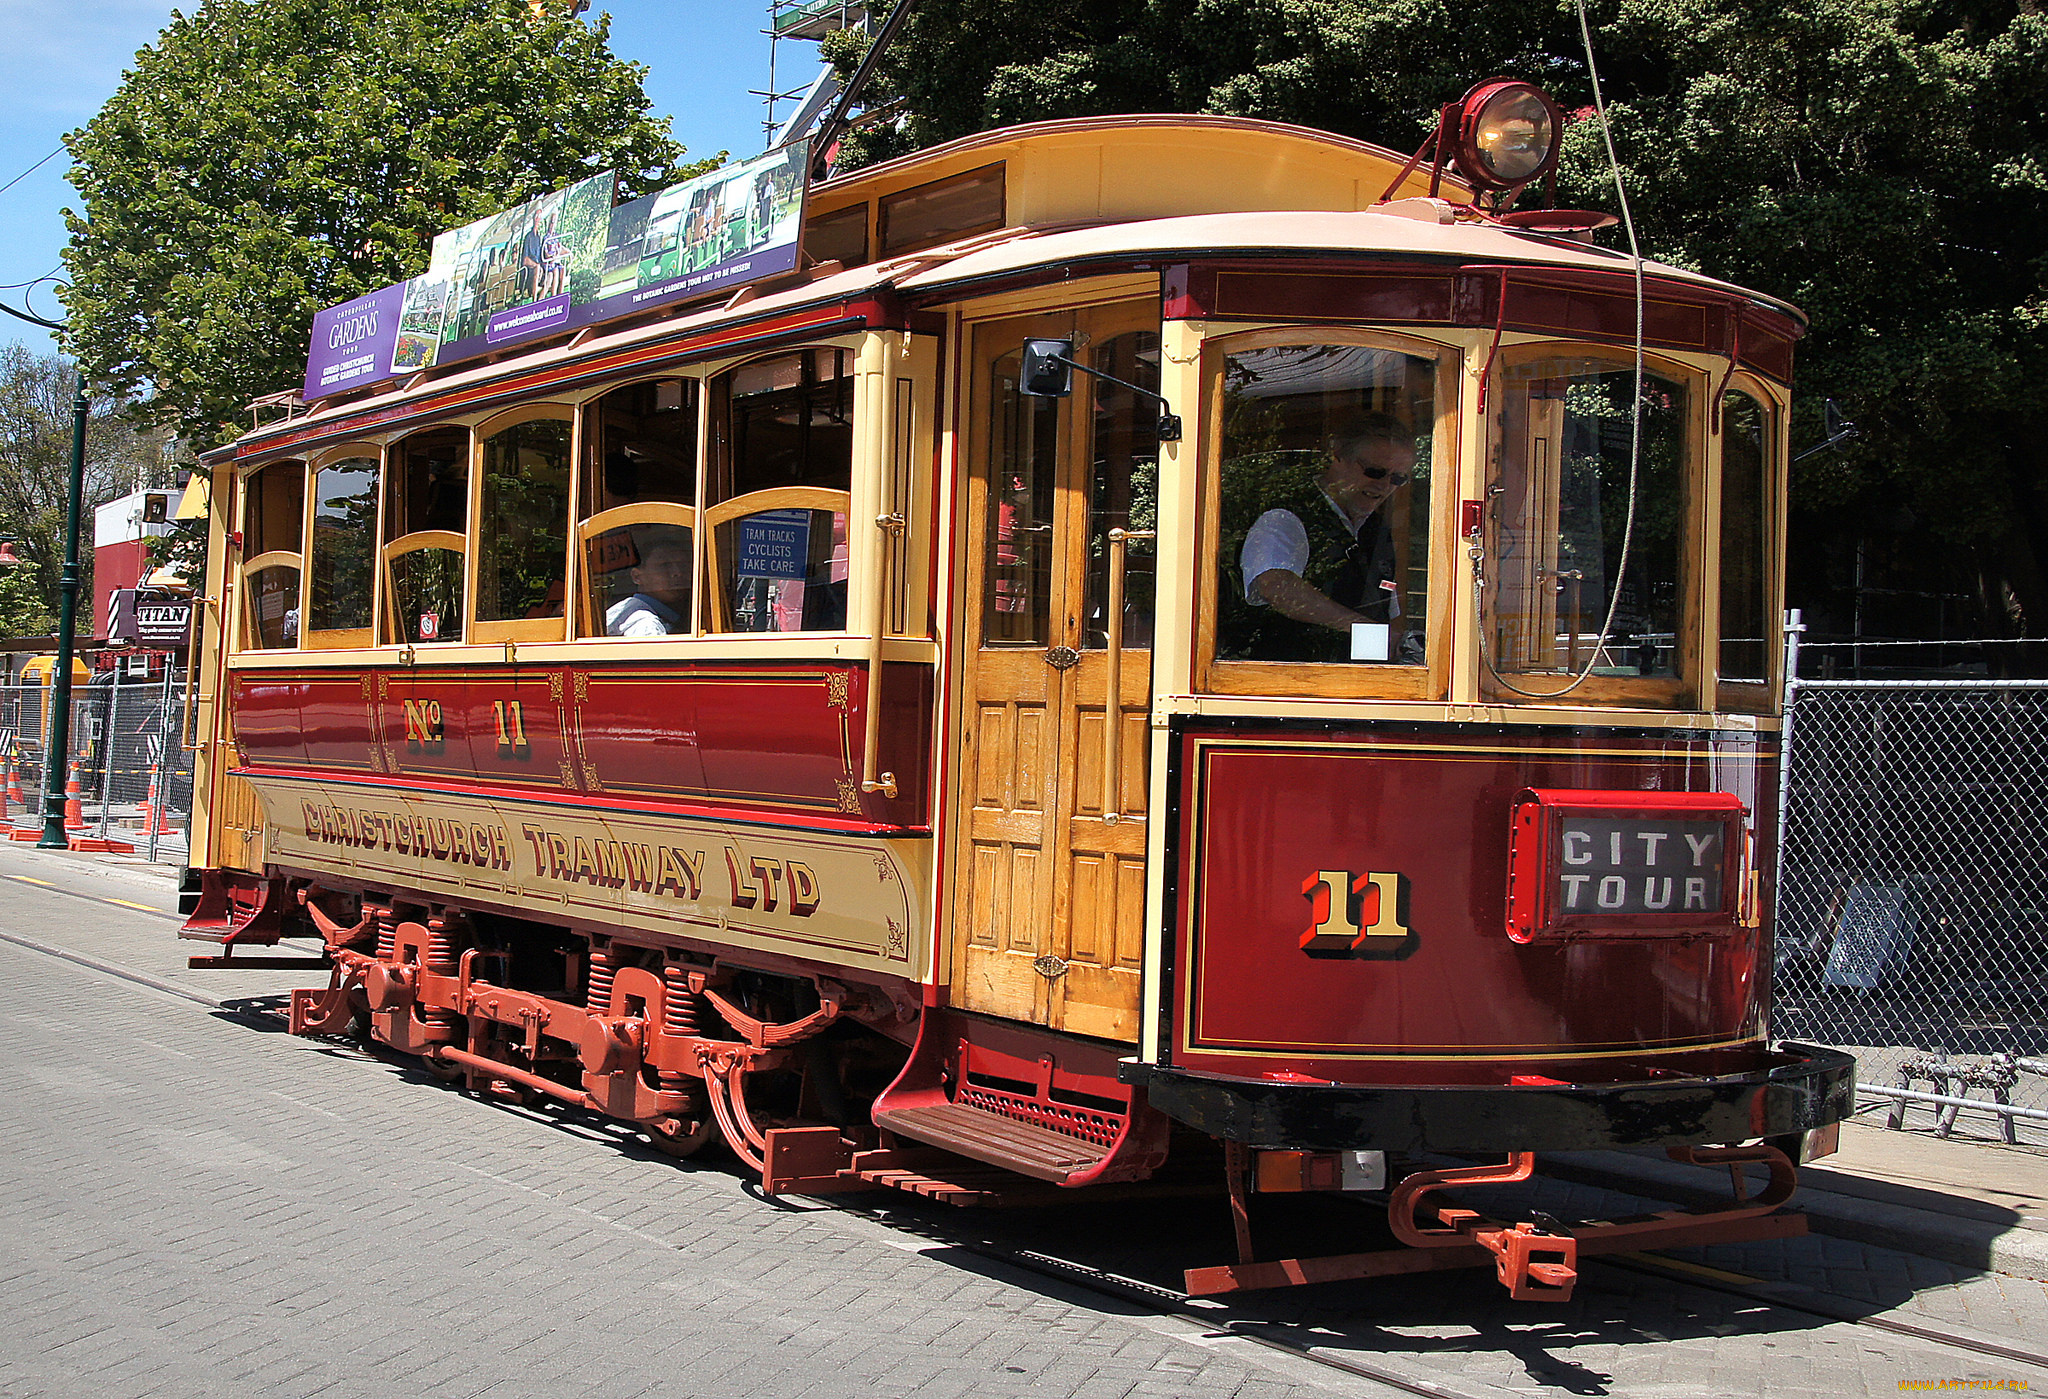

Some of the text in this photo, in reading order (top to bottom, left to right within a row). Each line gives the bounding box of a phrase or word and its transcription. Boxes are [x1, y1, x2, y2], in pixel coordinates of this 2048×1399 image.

[336, 299, 377, 320] CATERPILLAR
[328, 310, 379, 350] GARDENS
[746, 527, 796, 543] TRAM TRACKS
[748, 543, 792, 558] CYCLISTS
[742, 558, 795, 573] TAKE CARE
[138, 606, 187, 622] TITAN
[492, 699, 529, 747] 11
[300, 797, 822, 918] CHRISTCHURCH TRAMWAY LTD
[1562, 831, 1715, 867] CITY
[1303, 868, 1412, 949] 11
[1560, 874, 1707, 910] TOUR
